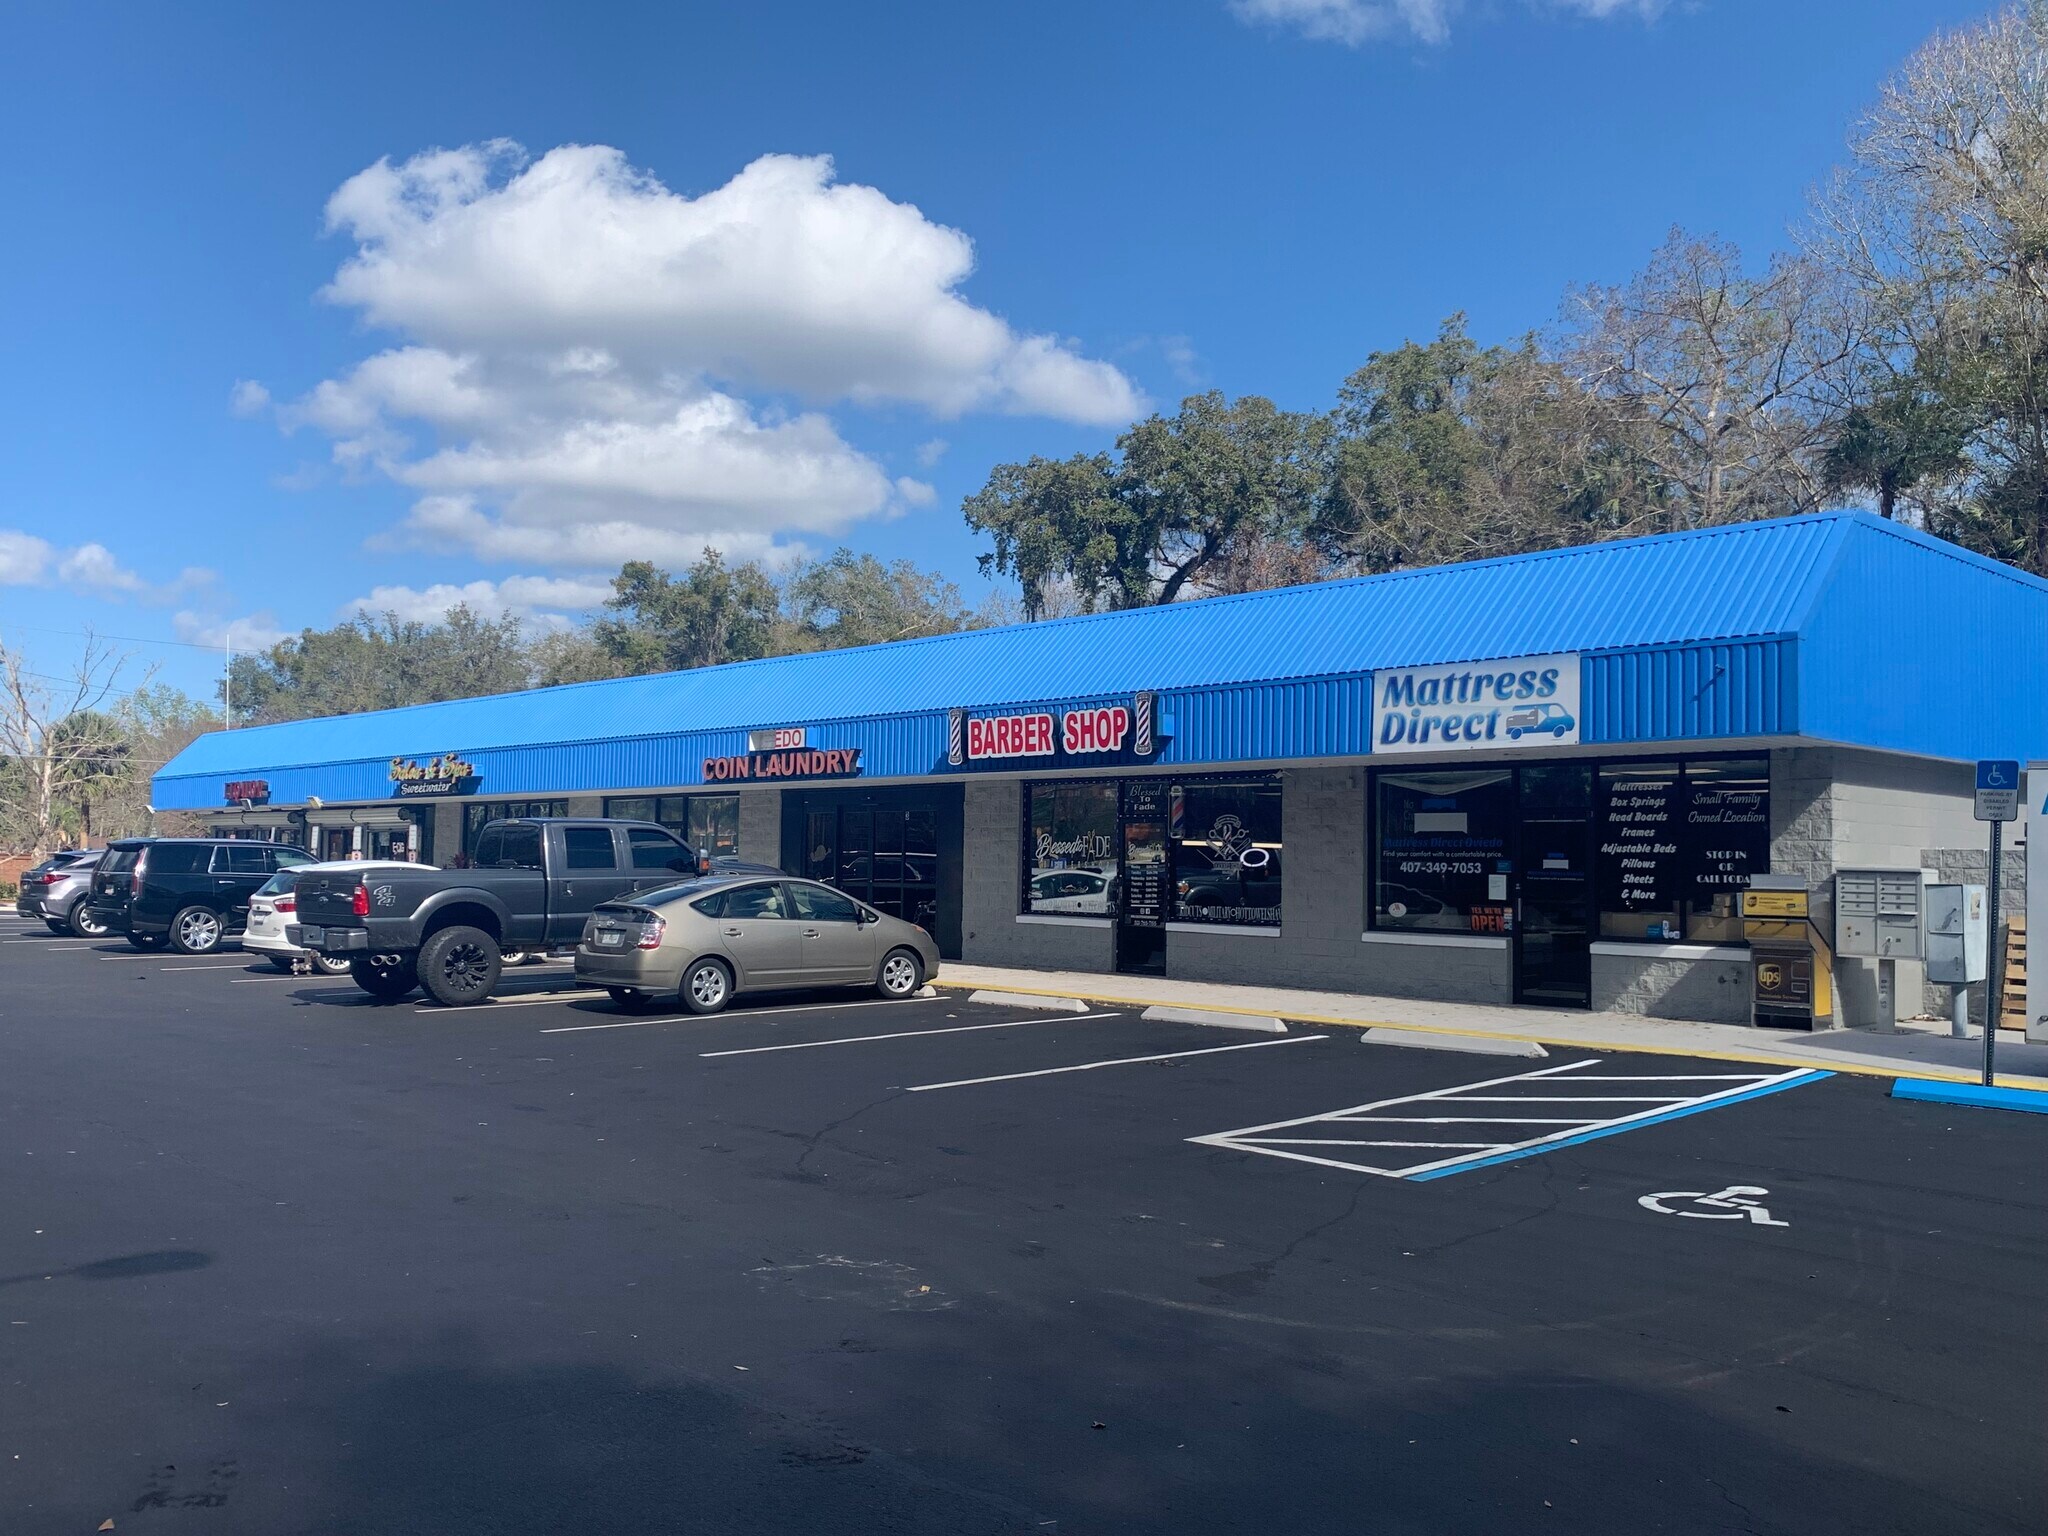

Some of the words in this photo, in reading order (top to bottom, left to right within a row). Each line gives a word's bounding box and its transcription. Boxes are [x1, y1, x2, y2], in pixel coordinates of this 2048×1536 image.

[1381, 668, 1559, 708] Mattress
[970, 716, 1053, 756] BARBER
[1065, 709, 1126, 751] SHOP
[1380, 708, 1502, 745] Direct
[389, 757, 424, 780] Salon
[440, 753, 472, 784] Spa
[702, 756, 749, 780] COIN
[755, 750, 855, 778] LAUNDRY
[401, 782, 452, 795] Sweetwater
[1129, 784, 1163, 797] Blessed
[1611, 782, 1664, 791] Mattresses
[1610, 797, 1628, 806] Box
[1629, 797, 1666, 808] Springs
[1692, 792, 1722, 804] Small
[1723, 792, 1760, 809] Family
[1609, 812, 1634, 821] Head
[1634, 812, 1668, 821] Boards
[1688, 809, 1724, 823] Owned
[1722, 811, 1765, 822] Location
[1621, 827, 1656, 837] Frames
[1601, 843, 1651, 855] Adjustable
[1653, 843, 1677, 853] Beds
[1706, 851, 1733, 859] STOP
[1735, 851, 1747, 859] IN
[1400, 862, 1482, 873] 407-349-7053
[1621, 859, 1656, 868] Pillows
[1718, 863, 1734, 871] OR
[1622, 873, 1655, 884] Sheets
[1696, 874, 1720, 883] CALL
[1723, 875, 1751, 884] TODA
[1621, 889, 1630, 898] &
[1631, 889, 1656, 899] More
[1471, 915, 1504, 931] OPEN
[1760, 971, 1779, 986] ups
